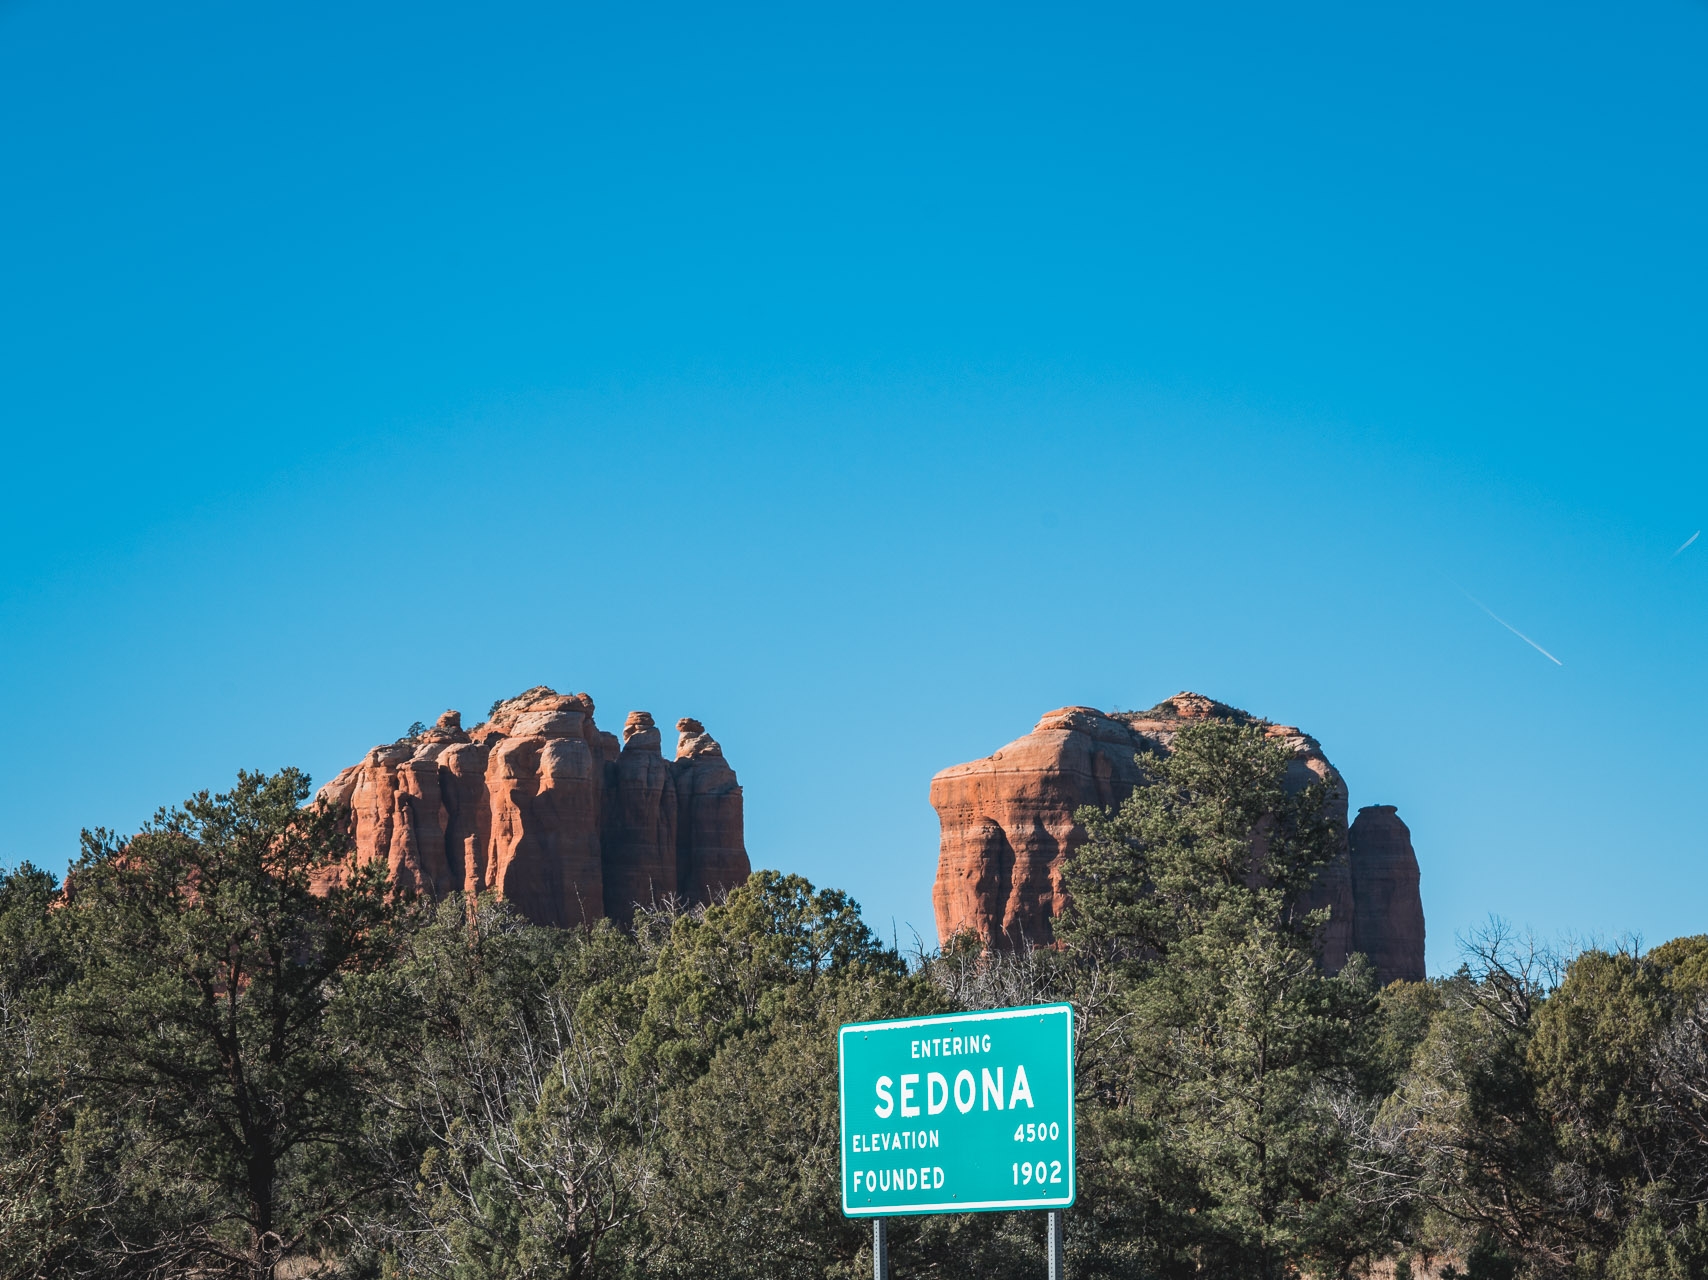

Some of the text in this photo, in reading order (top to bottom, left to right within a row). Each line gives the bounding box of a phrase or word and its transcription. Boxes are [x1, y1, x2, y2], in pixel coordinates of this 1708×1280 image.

[912, 1034, 991, 1058] ENTERING
[875, 1065, 1034, 1118] SEDONA
[853, 1122, 1059, 1152] ELEVATION 4500
[854, 1161, 1061, 1192] FOUNDED 1902
